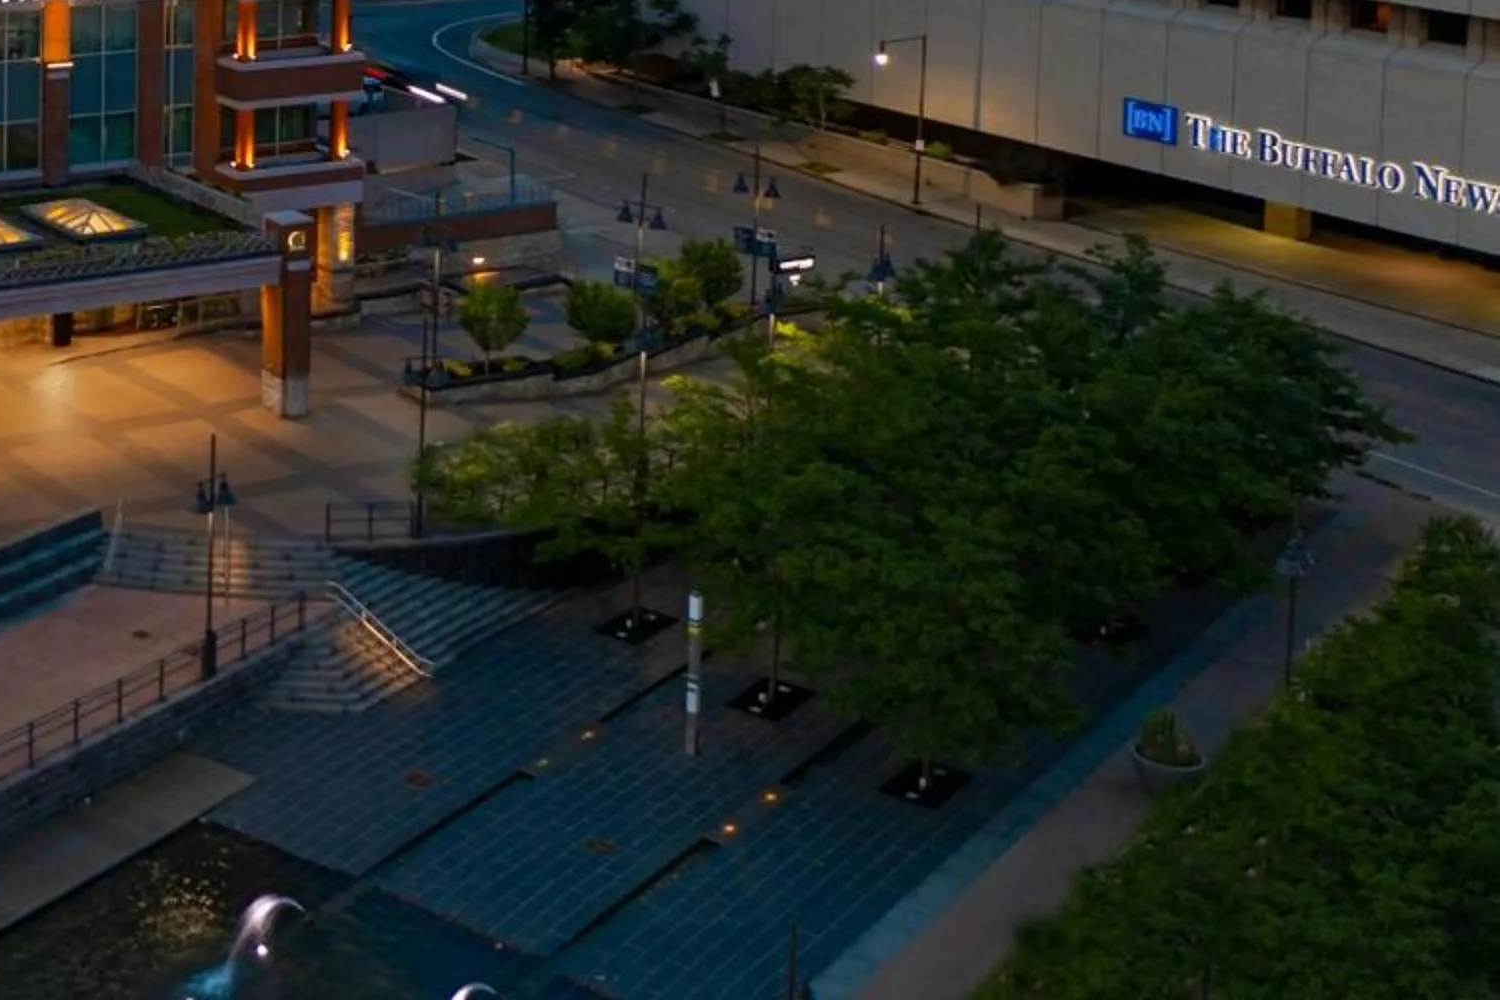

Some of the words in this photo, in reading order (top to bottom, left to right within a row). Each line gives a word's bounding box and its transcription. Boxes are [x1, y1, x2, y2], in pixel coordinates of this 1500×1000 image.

[1185, 112, 1251, 160] THE
[1257, 128, 1405, 193] BUFFALO
[1411, 161, 1500, 218] NEW
